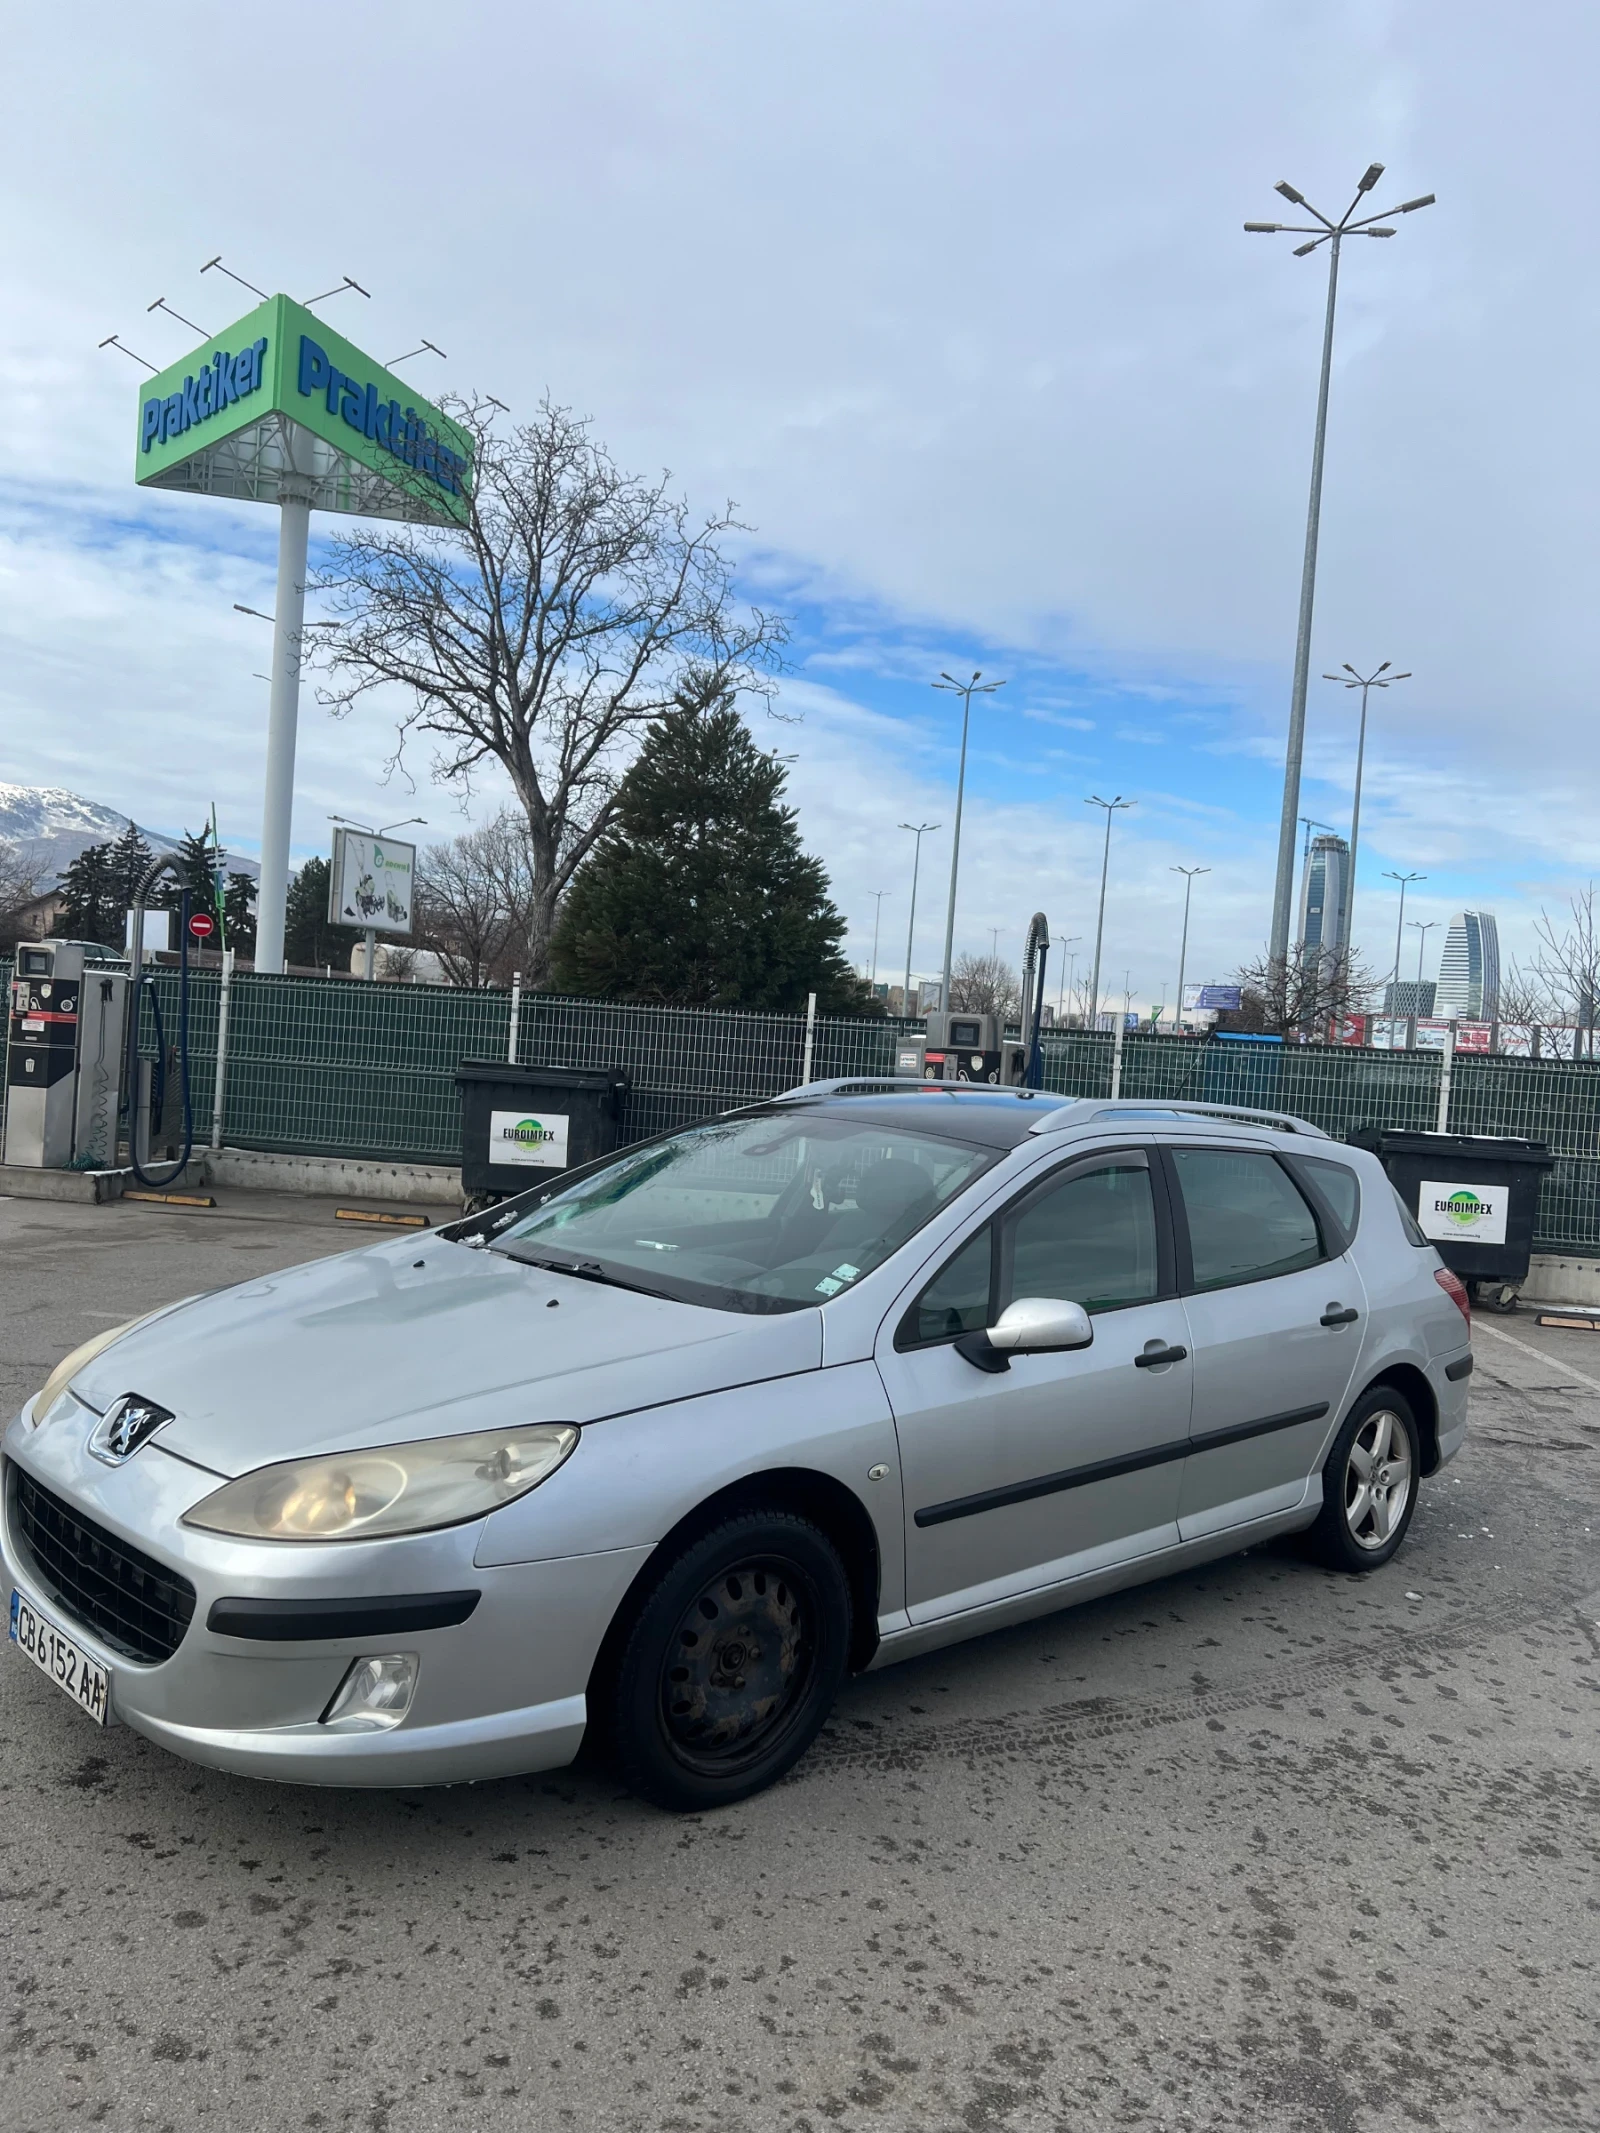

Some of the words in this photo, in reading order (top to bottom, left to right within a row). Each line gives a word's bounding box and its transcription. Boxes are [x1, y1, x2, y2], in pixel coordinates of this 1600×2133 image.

[141, 336, 268, 454] Praktiker
[297, 334, 467, 497] Praktiker
[503, 1127, 555, 1141] EUROIMPEX
[1434, 1200, 1493, 1215] EUROIMPEX
